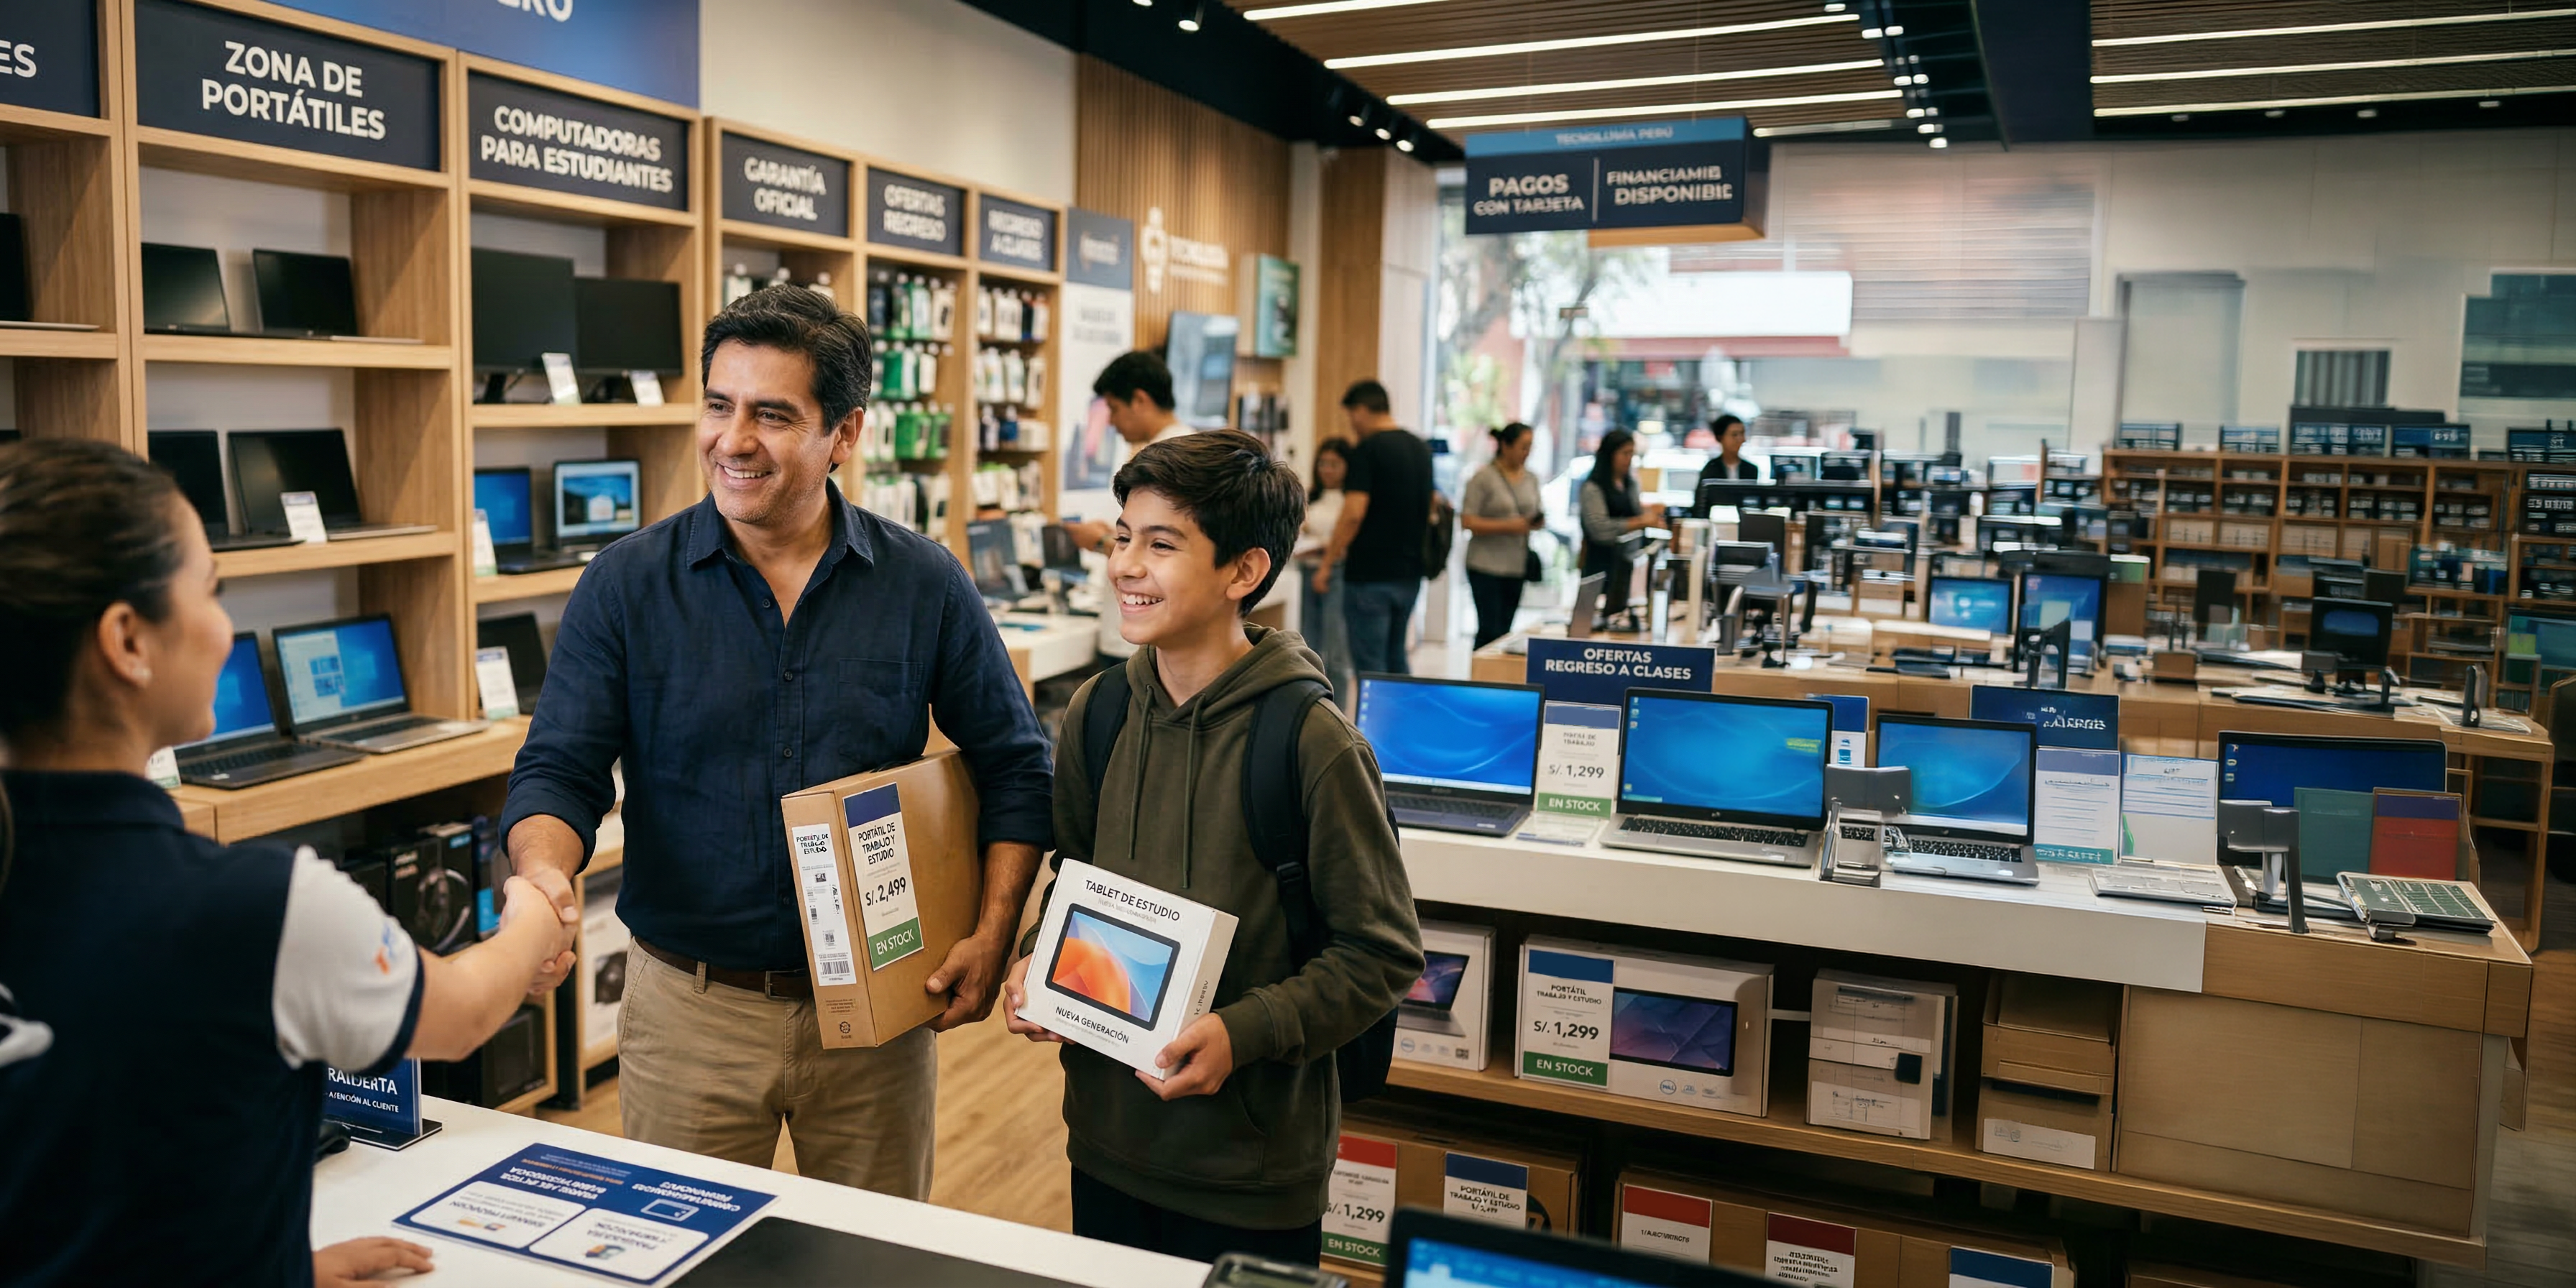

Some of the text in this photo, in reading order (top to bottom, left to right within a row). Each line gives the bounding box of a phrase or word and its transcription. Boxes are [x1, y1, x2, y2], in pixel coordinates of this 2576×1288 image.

[225, 40, 363, 98] ZONA DE
[202, 78, 386, 140] PORTÁTILES
[494, 106, 661, 162] COMPUTADORAS
[481, 134, 673, 193] PARA ESTUDIANTES
[744, 156, 827, 196] GARANTÍA
[1489, 173, 1570, 198] PAGOS
[753, 187, 819, 221] OFICIAL
[1473, 200, 1510, 216] CON
[1583, 648, 1652, 663] OFERTAS
[1545, 658, 1692, 680] REGRESO A CLASES
[1565, 764, 1605, 778] 1,299
[1548, 797, 1601, 812] EN STOCK
[857, 822, 896, 843] PORTÁTIL DE
[890, 834, 896, 845] Y
[868, 847, 894, 865] ESTUDIO
[1085, 880, 1121, 900] TABLET
[1120, 893, 1136, 906] DE
[1136, 898, 1180, 921] ESTUDIO
[875, 928, 915, 955] EN STOCK
[1055, 1006, 1080, 1023] NUEVA
[1080, 1017, 1130, 1044] GENERACIÓN
[1533, 1020, 1599, 1040] S/. 1,299
[1536, 1058, 1593, 1077] EN STOCK
[362, 1098, 372, 1107] AL
[1498, 1192, 1511, 1201] DE
[1343, 1203, 1386, 1223] 1,299
[1328, 1238, 1381, 1257] EN STOCK
